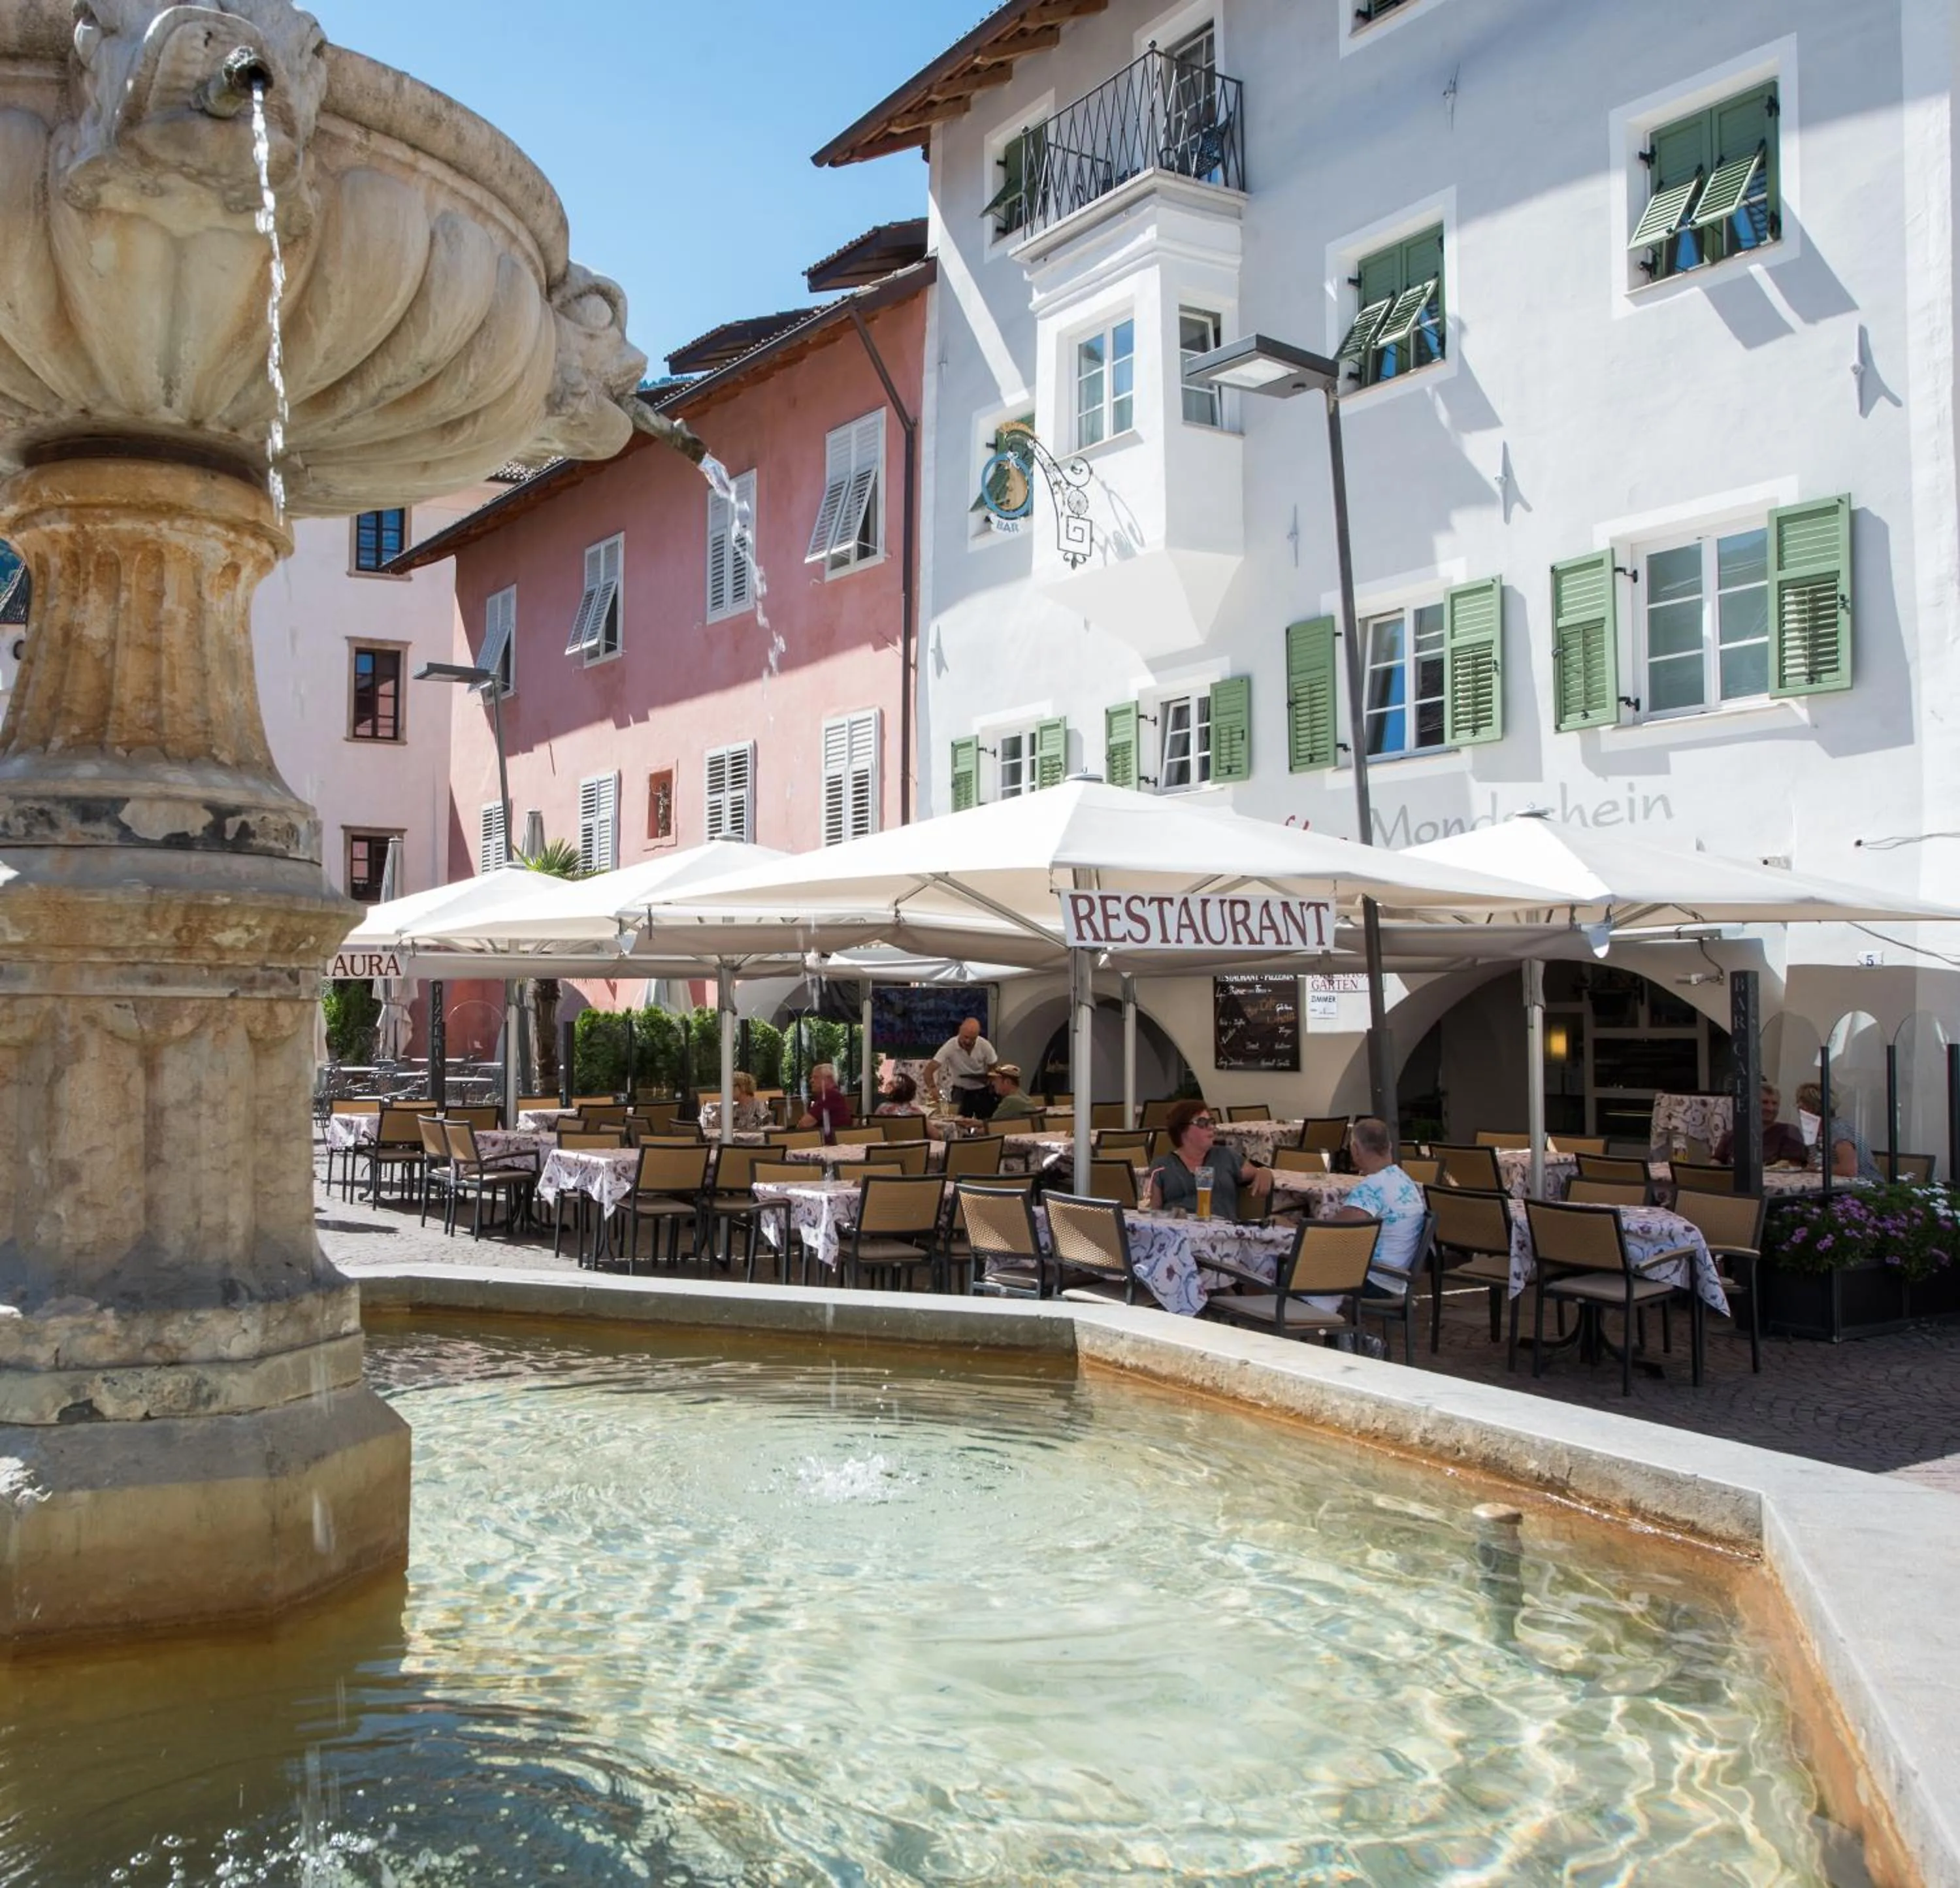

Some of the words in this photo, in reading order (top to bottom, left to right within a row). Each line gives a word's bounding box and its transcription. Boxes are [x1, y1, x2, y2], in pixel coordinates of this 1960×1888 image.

[1370, 781, 1674, 847] Mondhein
[1068, 894, 1330, 946] RESTAURANT
[323, 954, 401, 977] AURA
[1866, 954, 1874, 967] 5
[1311, 979, 1358, 990] GARTEN
